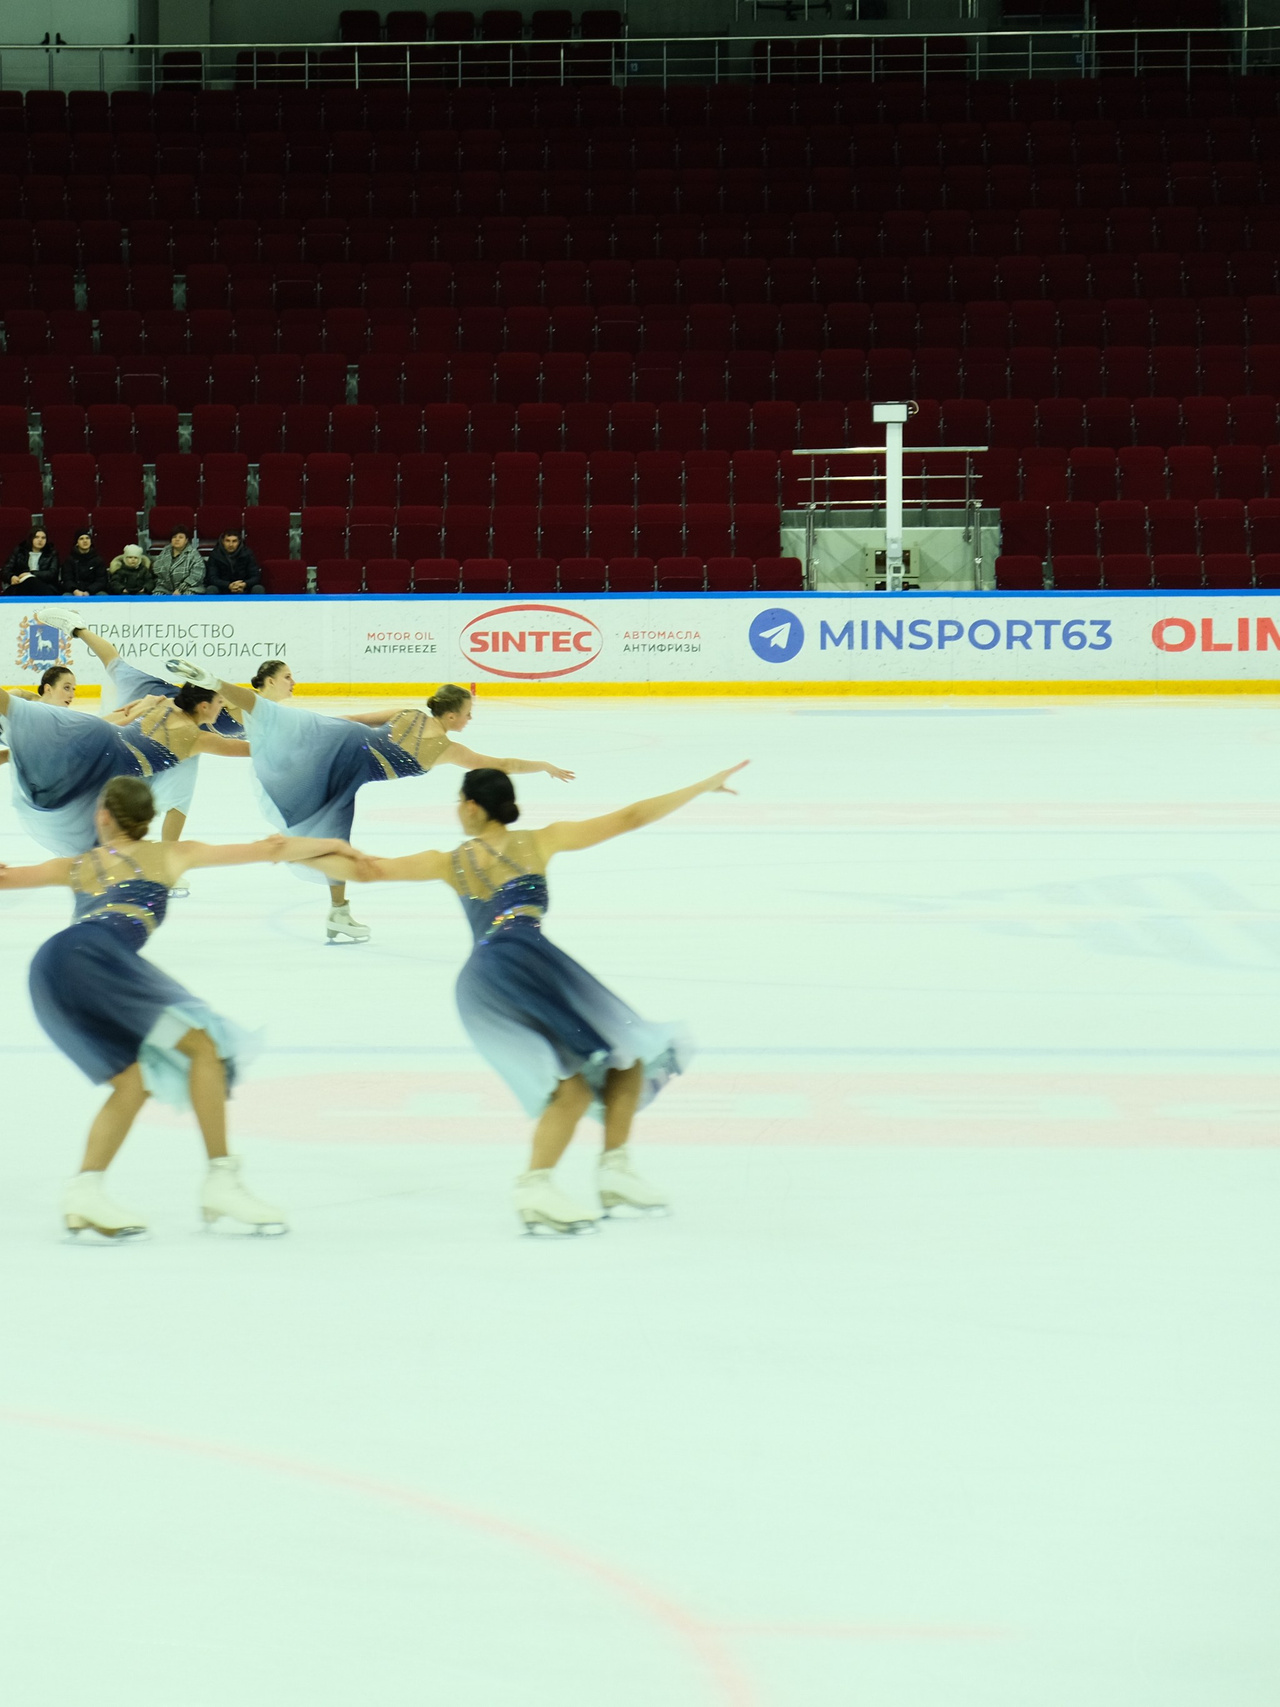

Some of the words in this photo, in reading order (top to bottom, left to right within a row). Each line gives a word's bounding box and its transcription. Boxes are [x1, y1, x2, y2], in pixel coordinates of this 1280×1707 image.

[88, 623, 234, 638] ПРАВИТЕЛЬСТВО
[367, 632, 411, 641] MOTOR
[414, 632, 435, 641] OIL
[623, 630, 701, 640] АВТОМАСЛА
[819, 619, 1113, 651] MINSPORT63
[470, 630, 592, 653] SINTEC
[623, 643, 701, 652] АНТИФРИЗЫ
[87, 640, 197, 657] СМАРСКОЙ
[203, 642, 286, 657] ОБЛАСТИ
[365, 644, 437, 653] ANTIFREEZE
